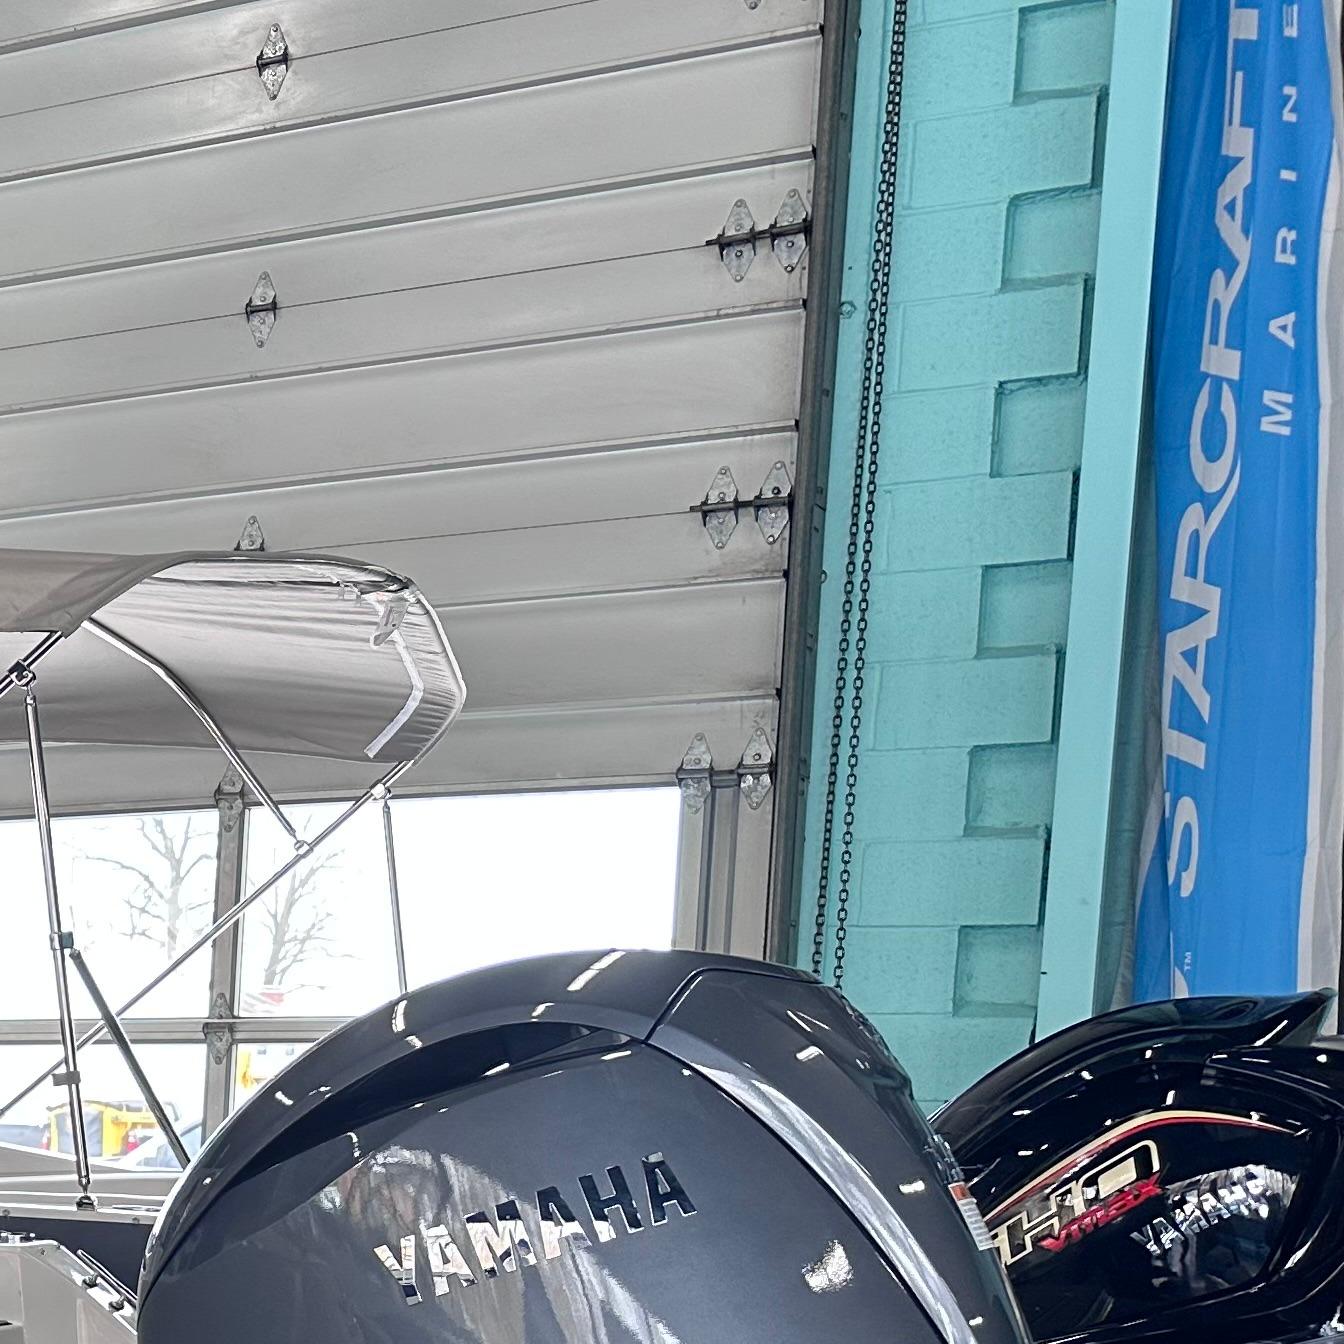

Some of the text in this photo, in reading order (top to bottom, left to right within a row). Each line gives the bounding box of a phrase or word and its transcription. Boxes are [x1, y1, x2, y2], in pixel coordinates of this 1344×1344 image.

[1260, 3, 1299, 436] MARINE
[1162, 0, 1260, 897] STARCRAFT
[373, 1151, 698, 1306] YAMAHA
